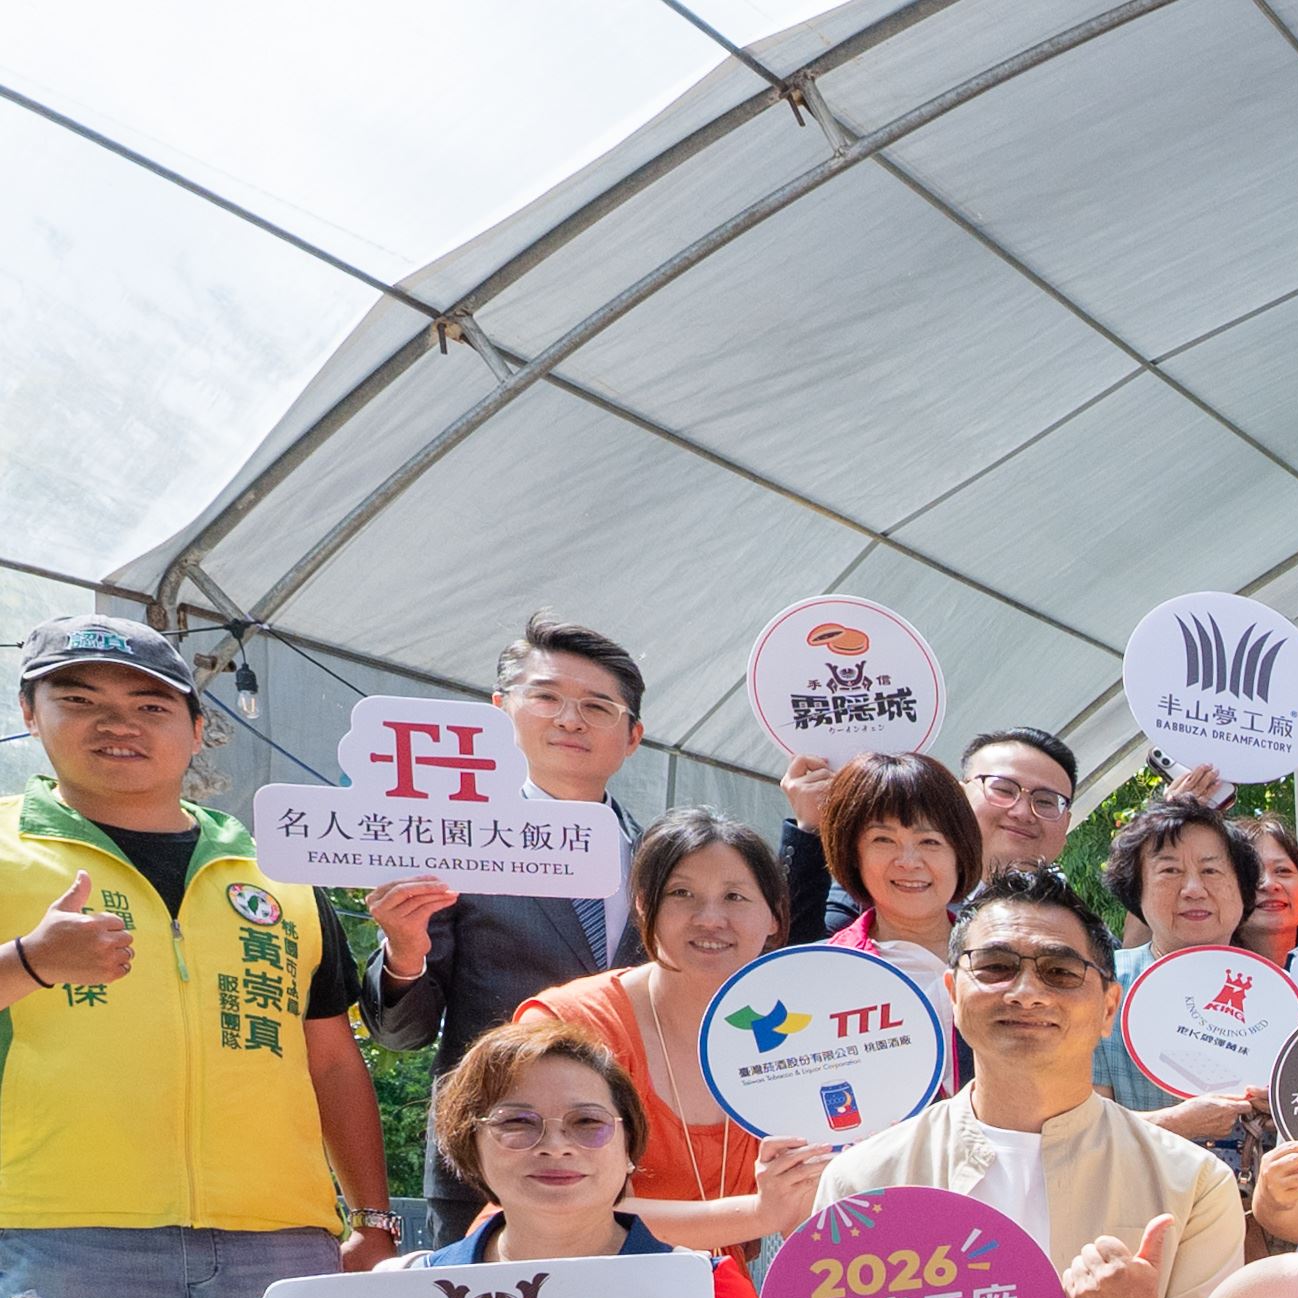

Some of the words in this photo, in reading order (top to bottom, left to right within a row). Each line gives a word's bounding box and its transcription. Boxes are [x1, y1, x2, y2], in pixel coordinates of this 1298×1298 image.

[1155, 718, 1208, 738] BABBUZA
[1212, 729, 1293, 753] DREAMFACTORY
[276, 807, 593, 854] 名人堂花園大飯店
[307, 851, 363, 866] FAME
[369, 853, 420, 868] HALL
[425, 856, 505, 873] GARDEN
[511, 861, 575, 876] HOTEL
[238, 926, 284, 1059] 黃崇真
[217, 973, 242, 1050] 服務團隊
[829, 1002, 905, 1039] TTL
[1202, 1002, 1246, 1025] KING
[1206, 1023, 1248, 1038] SPRING
[1247, 1019, 1270, 1036] BED
